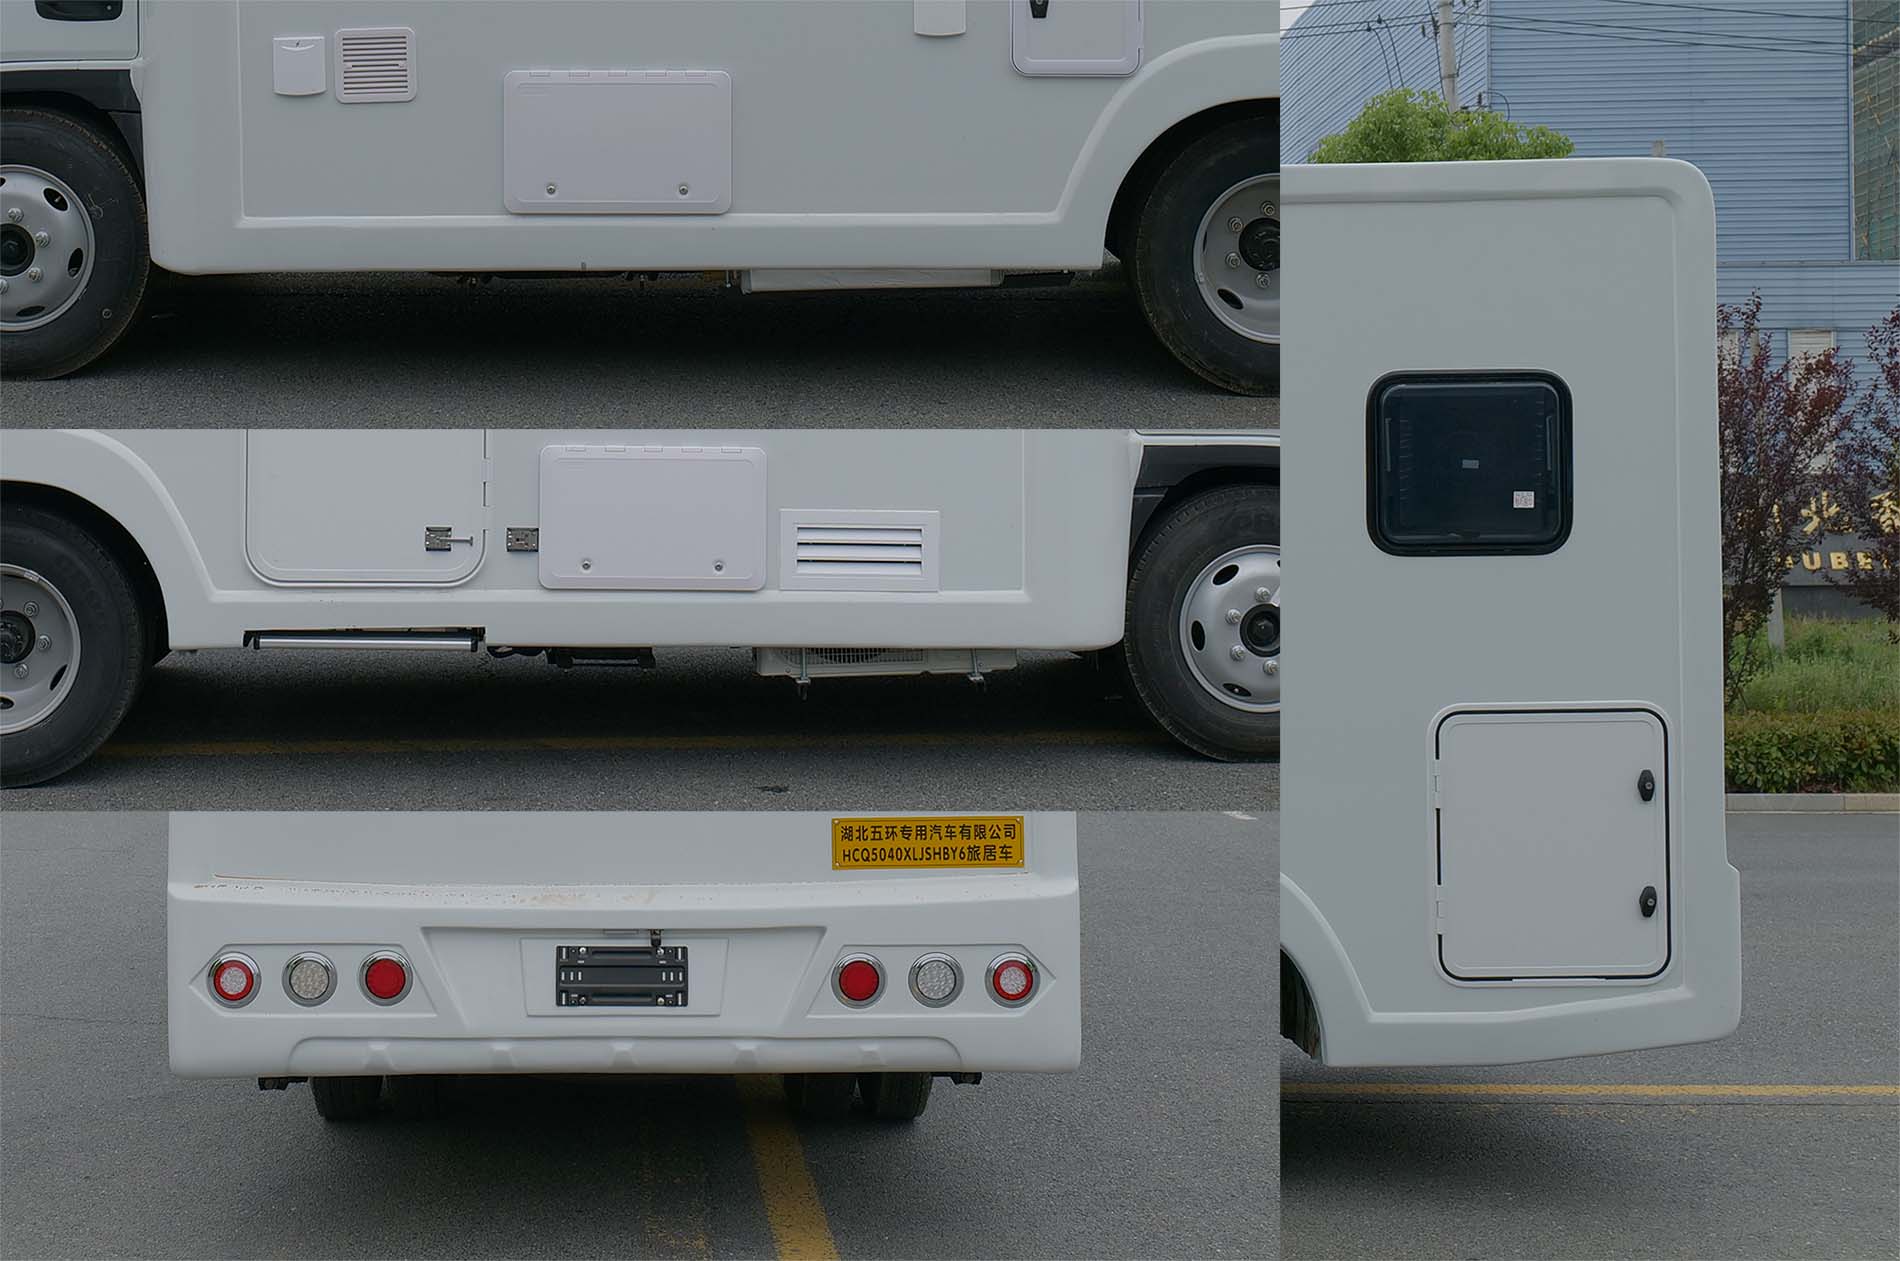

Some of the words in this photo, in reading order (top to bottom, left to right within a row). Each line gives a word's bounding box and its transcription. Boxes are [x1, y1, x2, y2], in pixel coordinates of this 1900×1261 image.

[840, 823, 1016, 841] 湖北五环专用汽车有限公司
[842, 845, 1013, 862] HCQ5040XLJSHBY6旅居车
